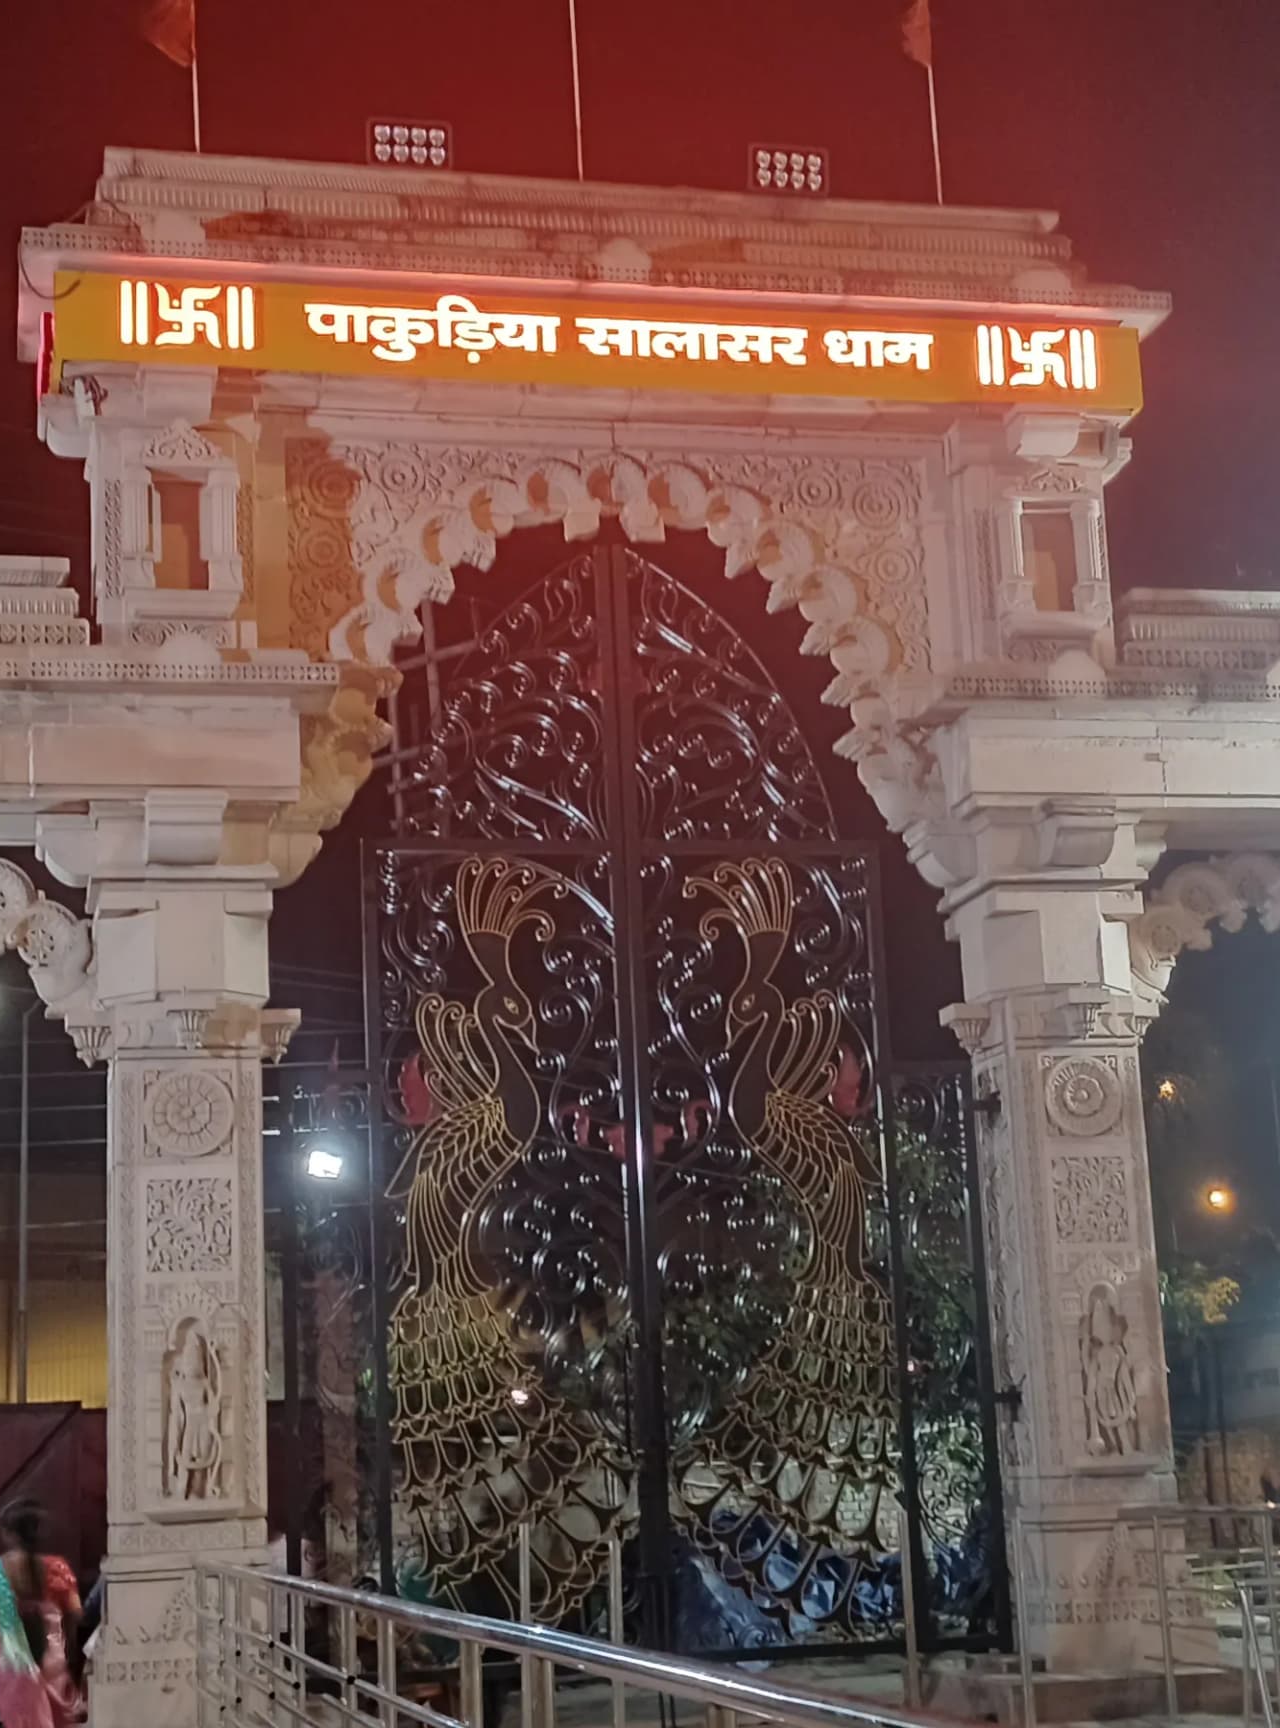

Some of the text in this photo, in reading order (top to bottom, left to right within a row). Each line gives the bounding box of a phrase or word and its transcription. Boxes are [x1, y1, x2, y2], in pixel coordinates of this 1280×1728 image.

[303, 294, 934, 371] पाकुड़िया सालासर धाम
